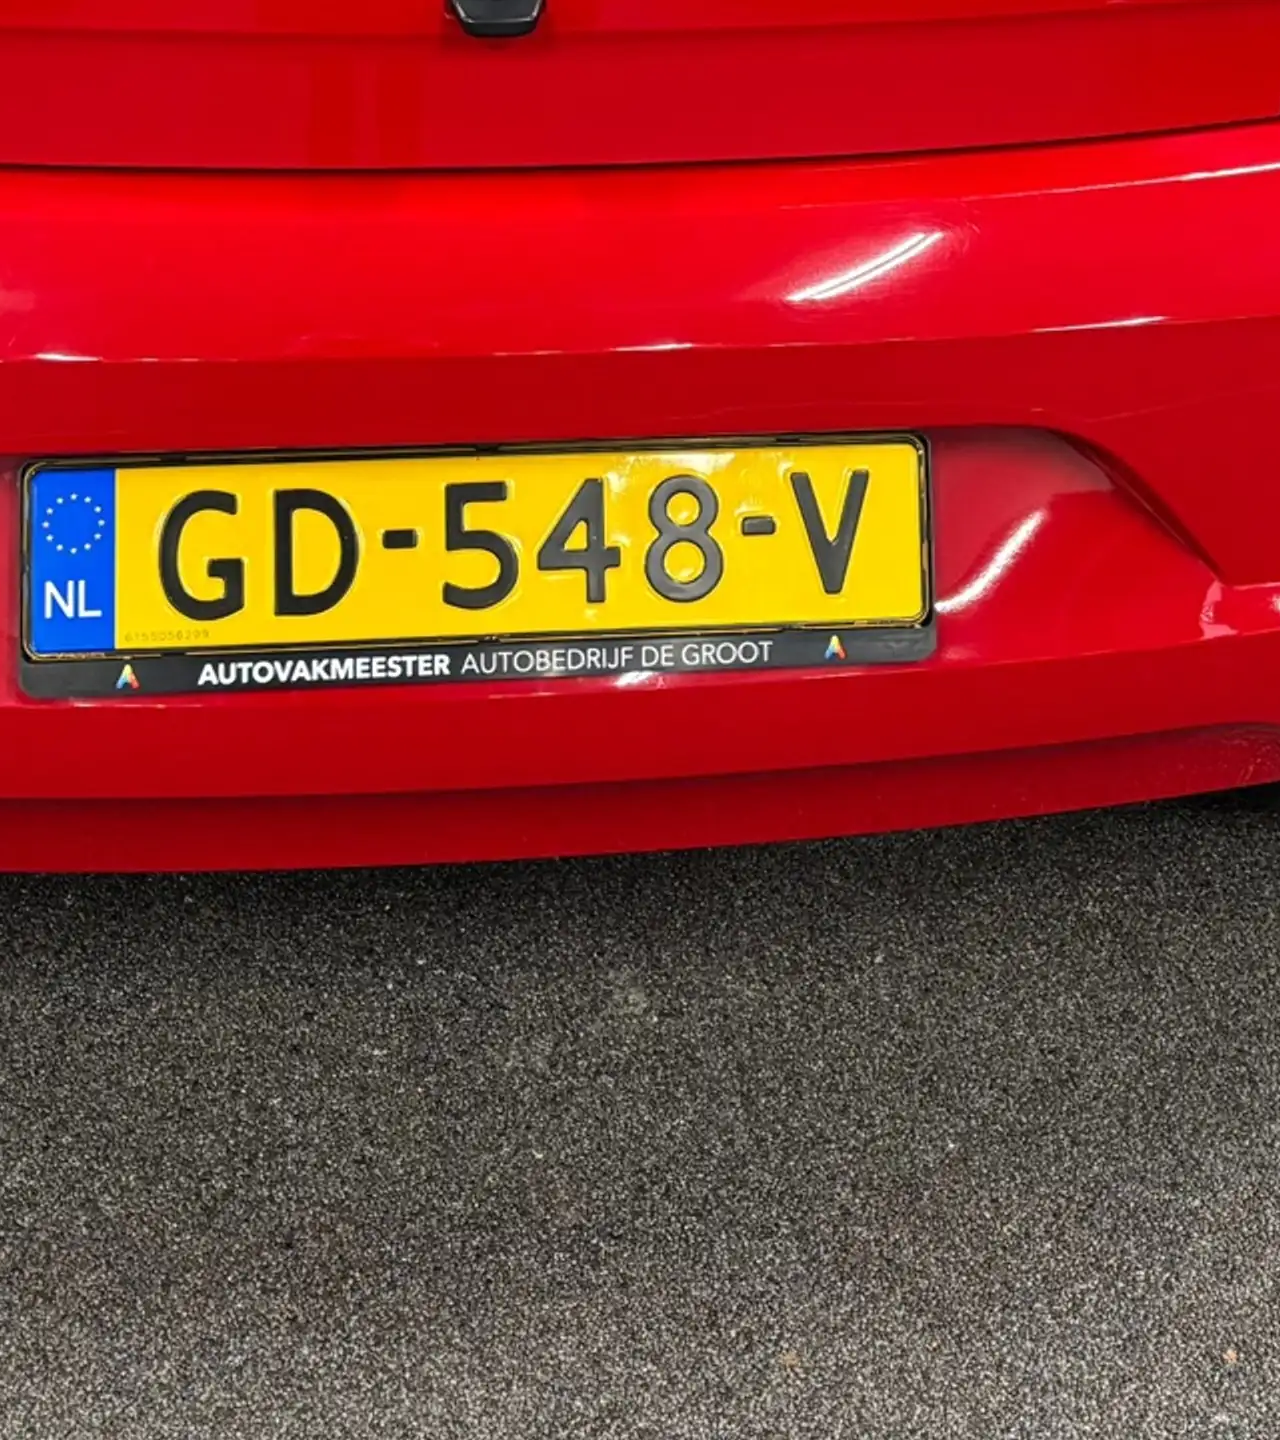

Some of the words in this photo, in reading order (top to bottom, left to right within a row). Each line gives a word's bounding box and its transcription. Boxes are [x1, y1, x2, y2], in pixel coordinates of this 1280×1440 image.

[158, 469, 870, 622] GD-548-V
[44, 579, 103, 620] NL
[197, 654, 451, 687] AUTOVAKMEESTER
[460, 645, 635, 675] AUTOBEDRIJF
[641, 644, 675, 667] DE
[681, 640, 774, 665] GROOT
